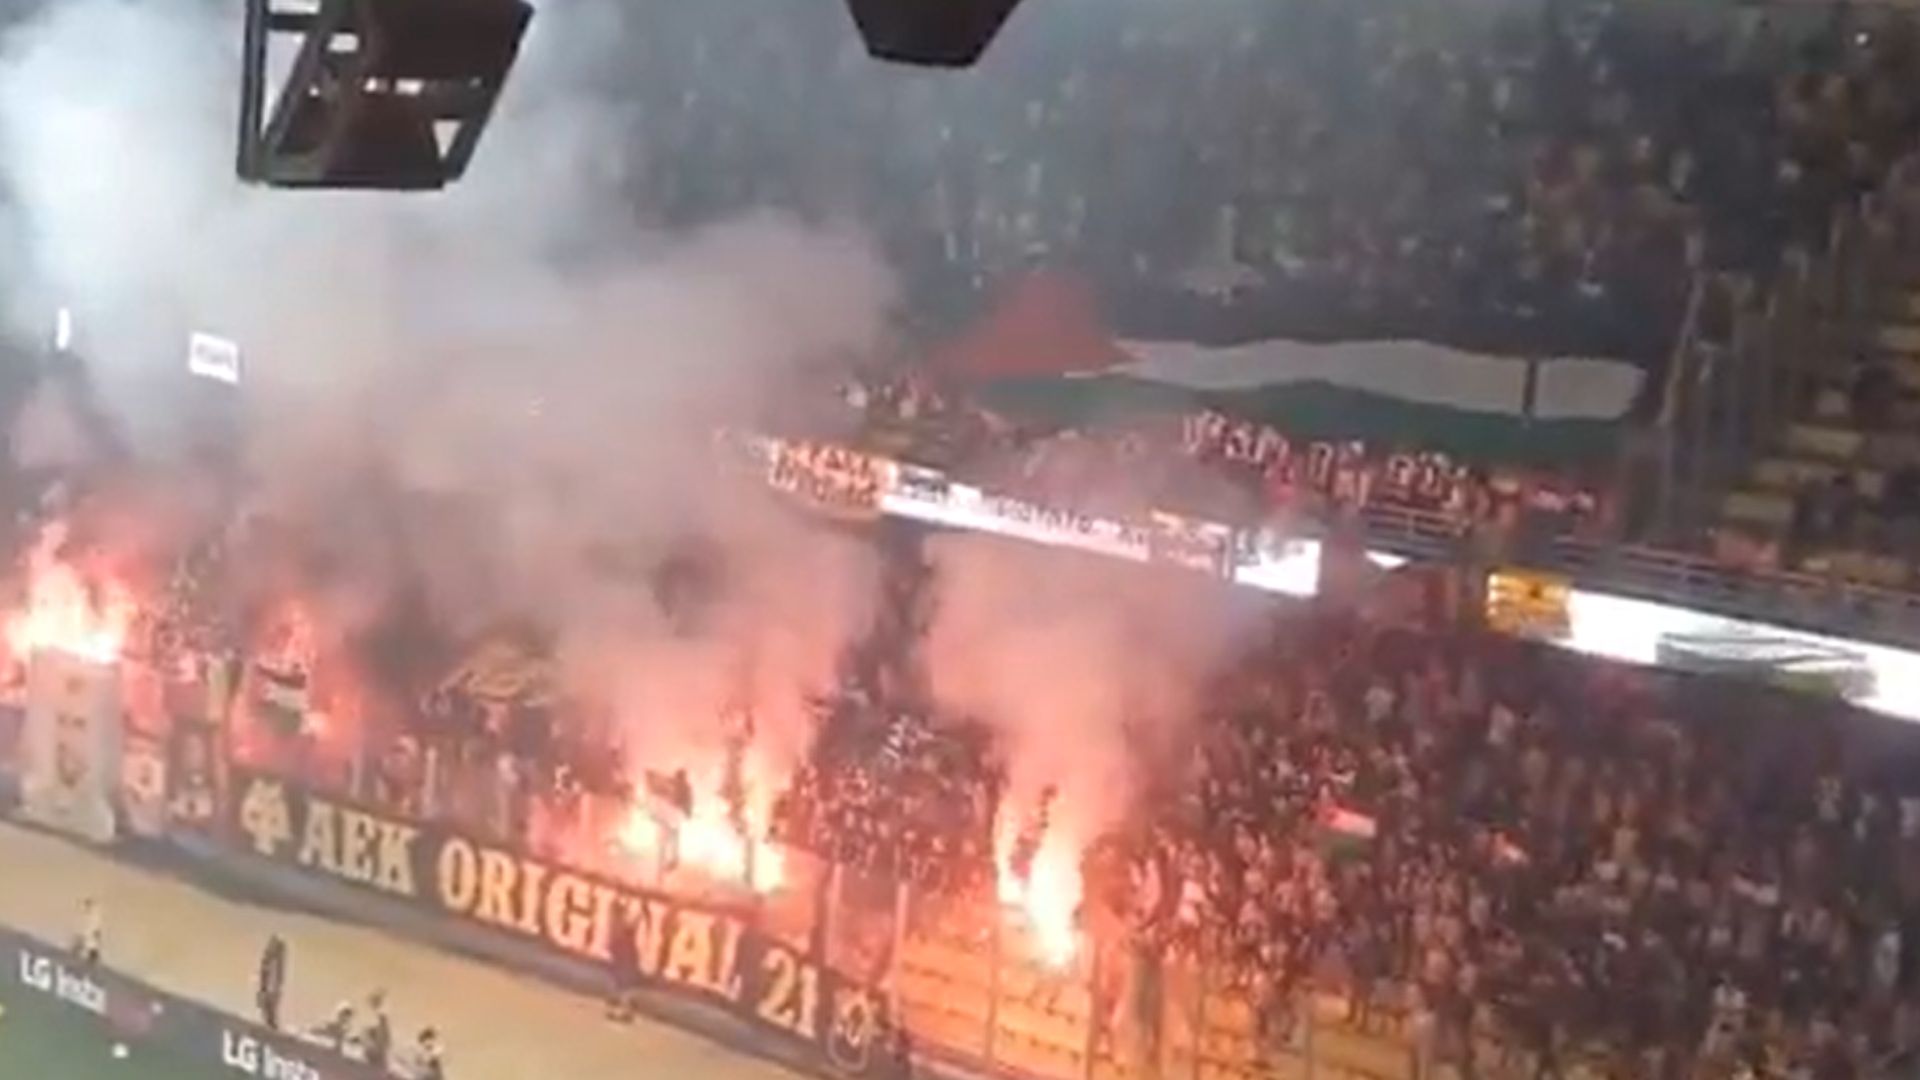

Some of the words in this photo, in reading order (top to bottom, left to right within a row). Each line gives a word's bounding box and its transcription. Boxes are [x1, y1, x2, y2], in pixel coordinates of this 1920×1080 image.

[298, 799, 418, 896] AEK
[437, 836, 744, 1001] ORIGINAL
[756, 946, 818, 1040] 21
[20, 949, 51, 991] LG
[223, 1028, 257, 1073] LG
